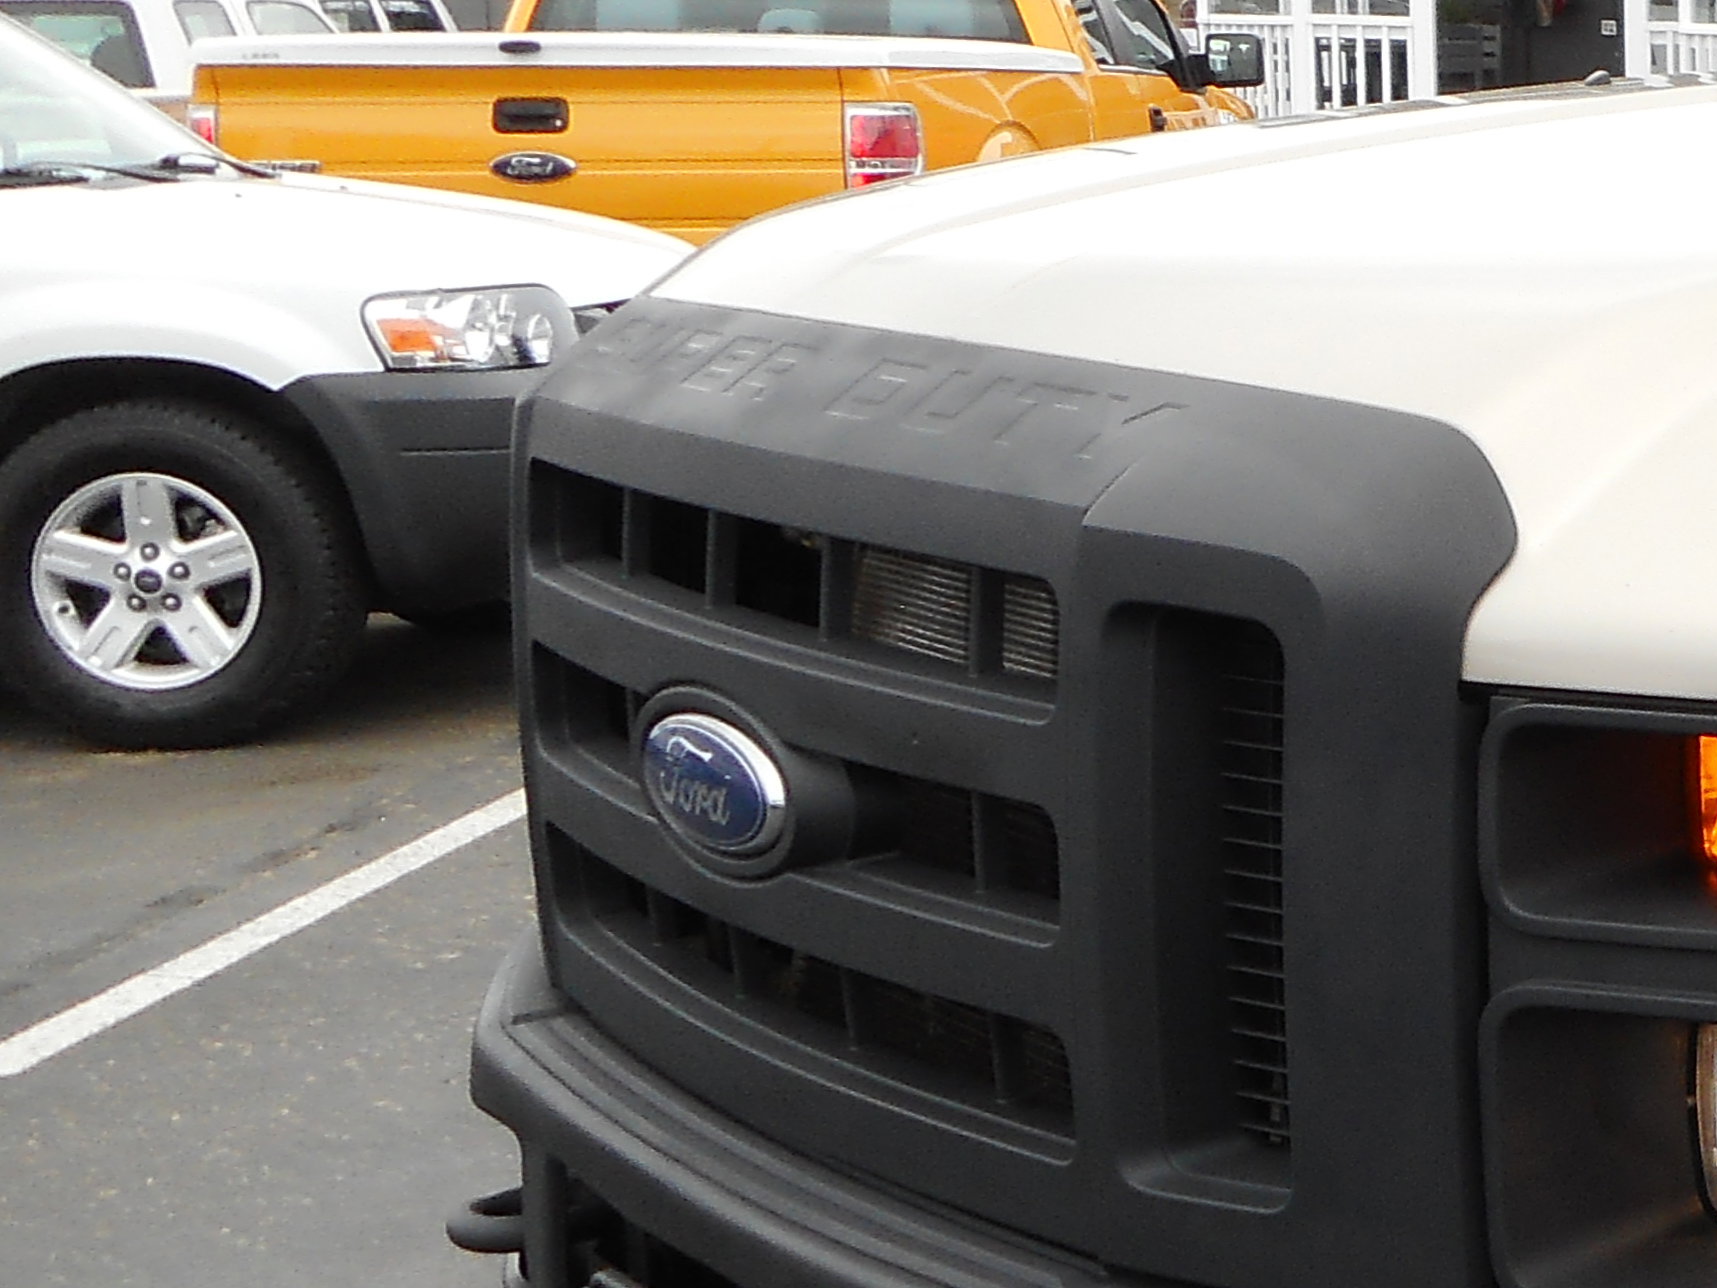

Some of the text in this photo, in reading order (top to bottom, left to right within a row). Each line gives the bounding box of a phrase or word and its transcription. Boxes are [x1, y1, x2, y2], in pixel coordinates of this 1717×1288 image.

[588, 314, 1192, 461] SUPER DUTY
[659, 735, 731, 827] Ford
